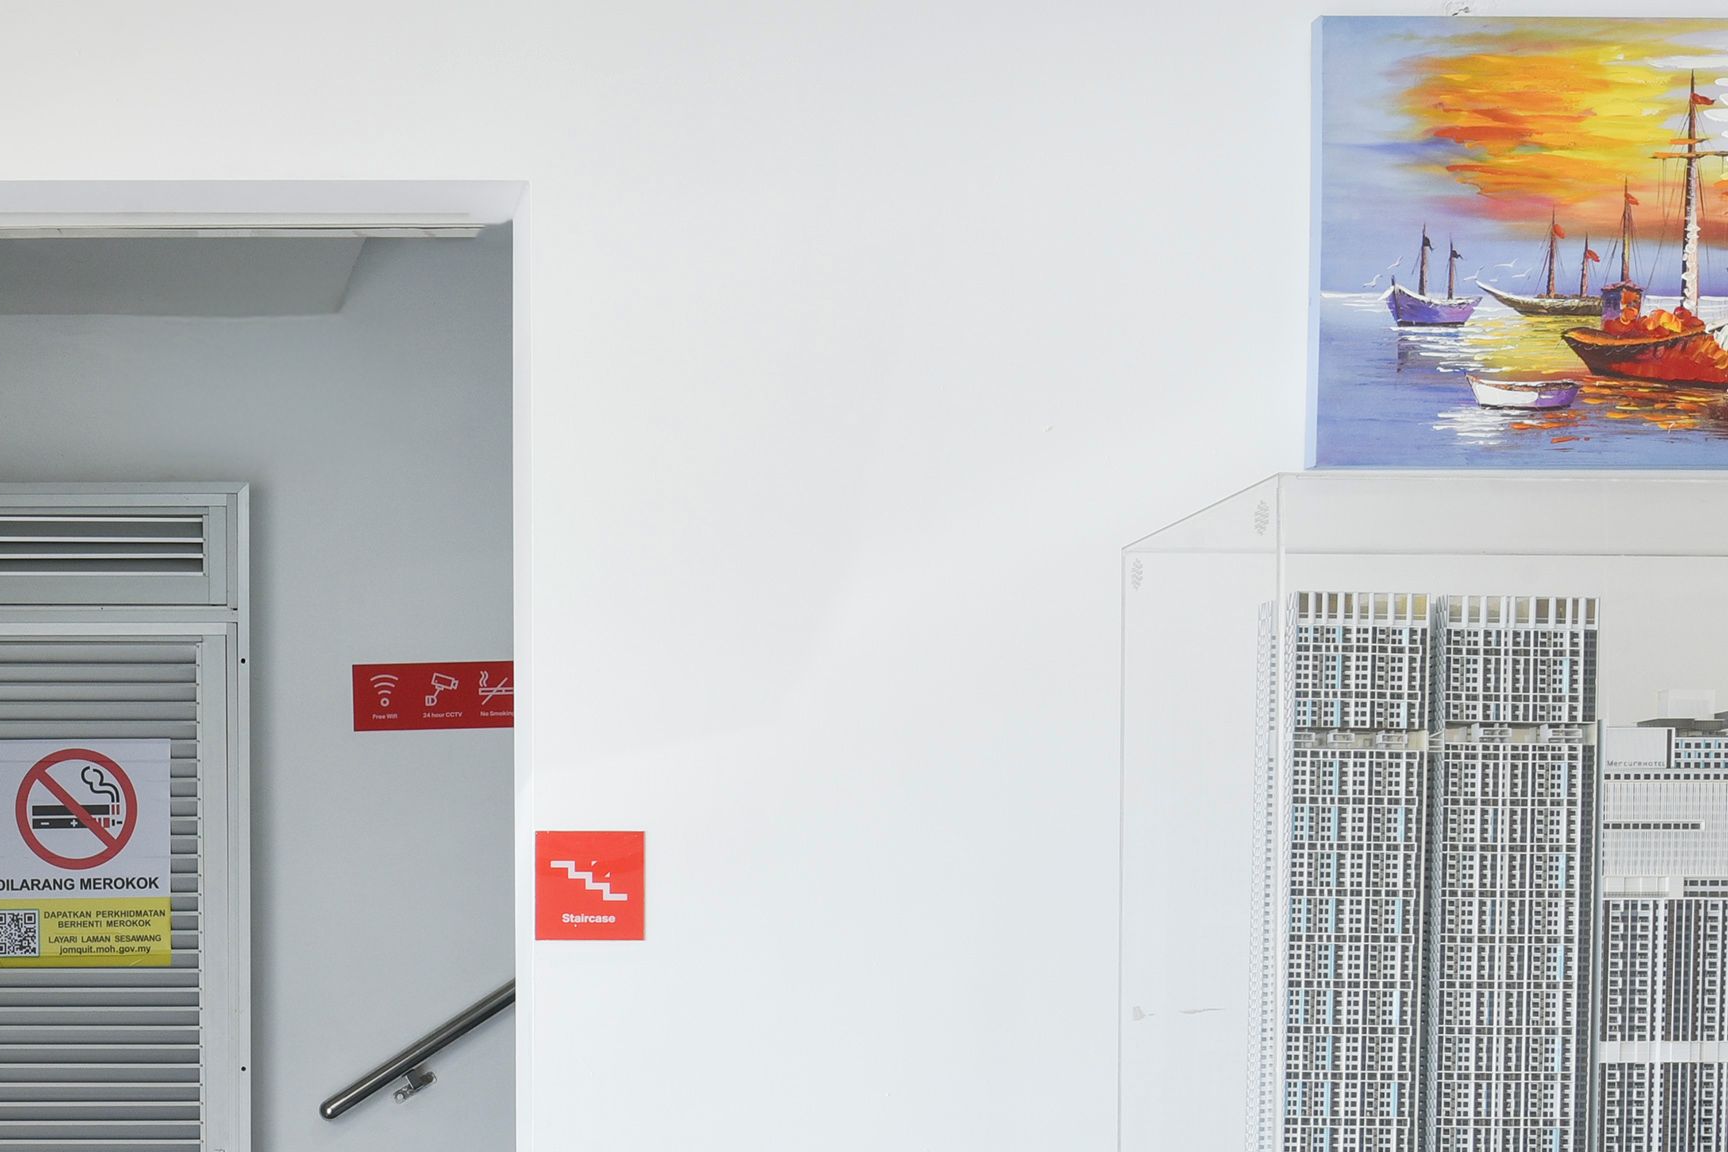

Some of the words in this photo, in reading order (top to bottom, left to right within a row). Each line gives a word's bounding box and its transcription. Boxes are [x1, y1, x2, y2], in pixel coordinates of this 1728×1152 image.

[80, 877, 160, 890] MEROKOK
[43, 910, 92, 919] DAPATKAN
[95, 909, 166, 918] PERKHIDMATAN
[562, 913, 616, 923] Staircase
[58, 920, 102, 928] BERHENTI
[106, 919, 151, 928] MEROKOK
[48, 935, 78, 944] LAYARI
[81, 935, 111, 943] LAMAN
[114, 934, 162, 943] SESAWANG
[59, 944, 151, 955] jomquit.moh.gov.my
